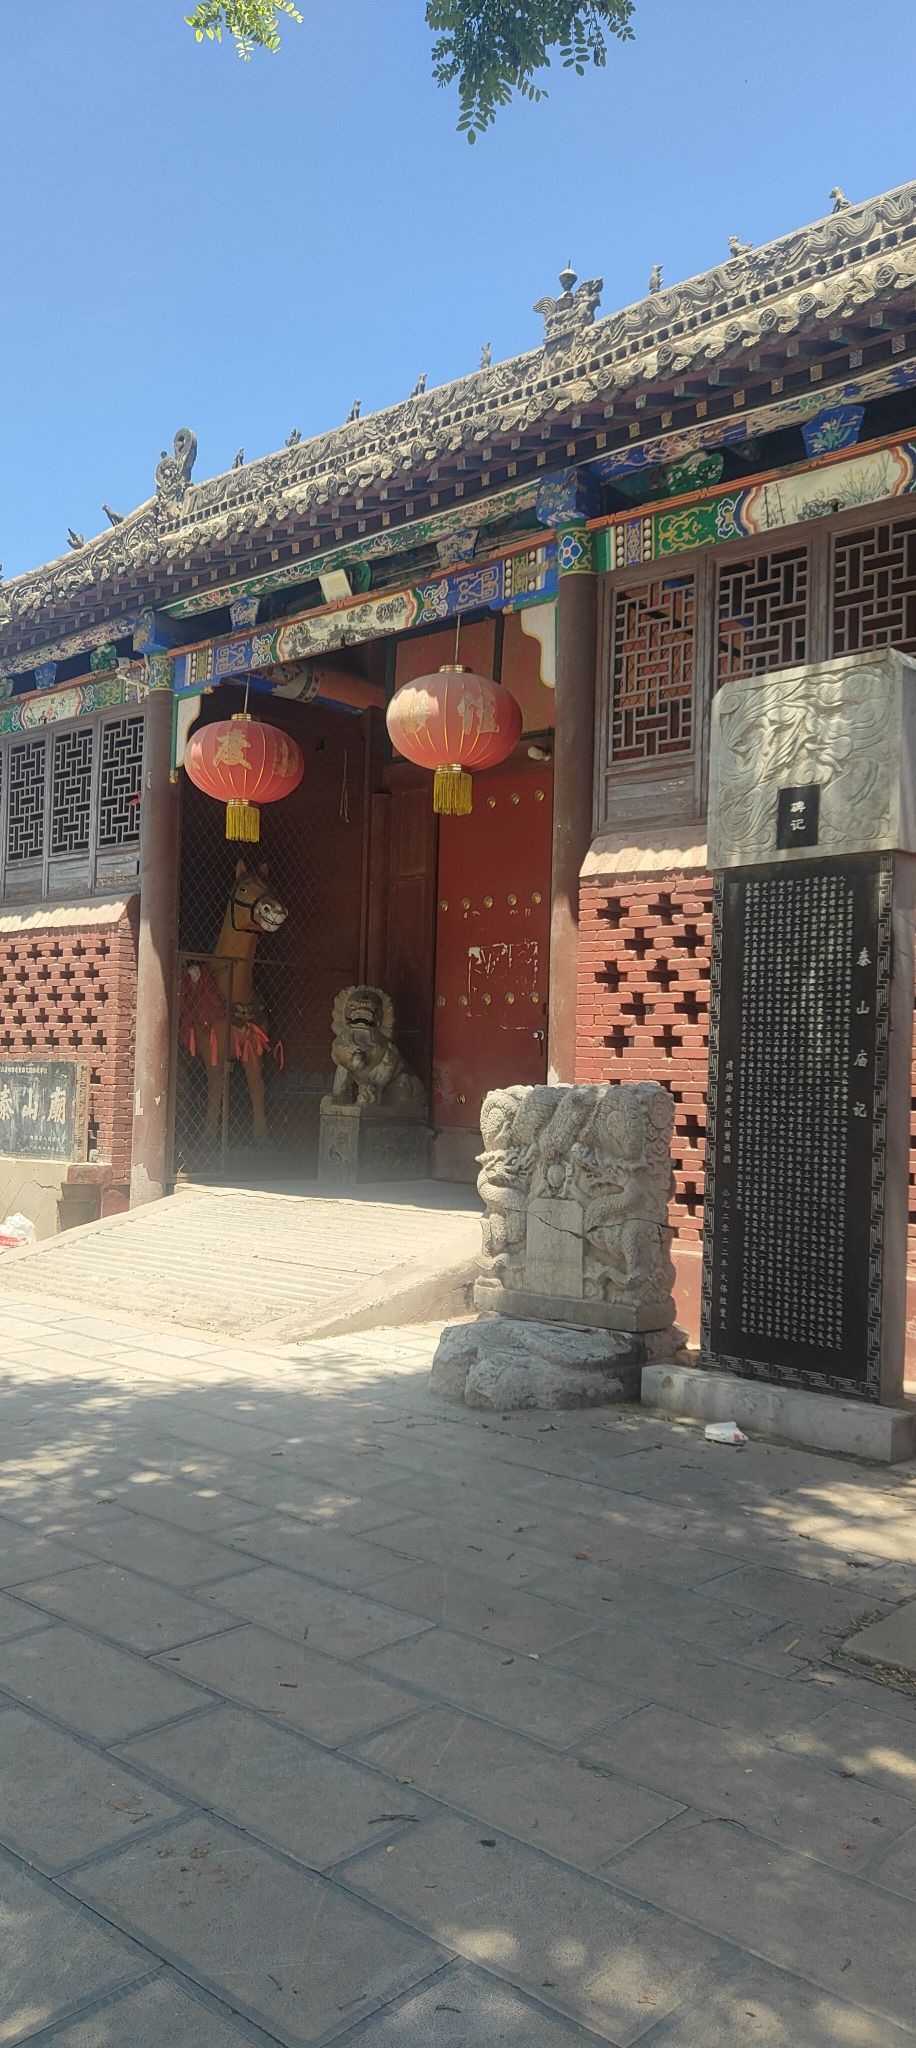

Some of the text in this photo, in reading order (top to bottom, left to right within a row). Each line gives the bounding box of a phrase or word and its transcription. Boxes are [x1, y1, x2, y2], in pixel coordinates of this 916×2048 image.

[789, 800, 807, 832] 碑记
[851, 946, 873, 1119] 泰山庙记
